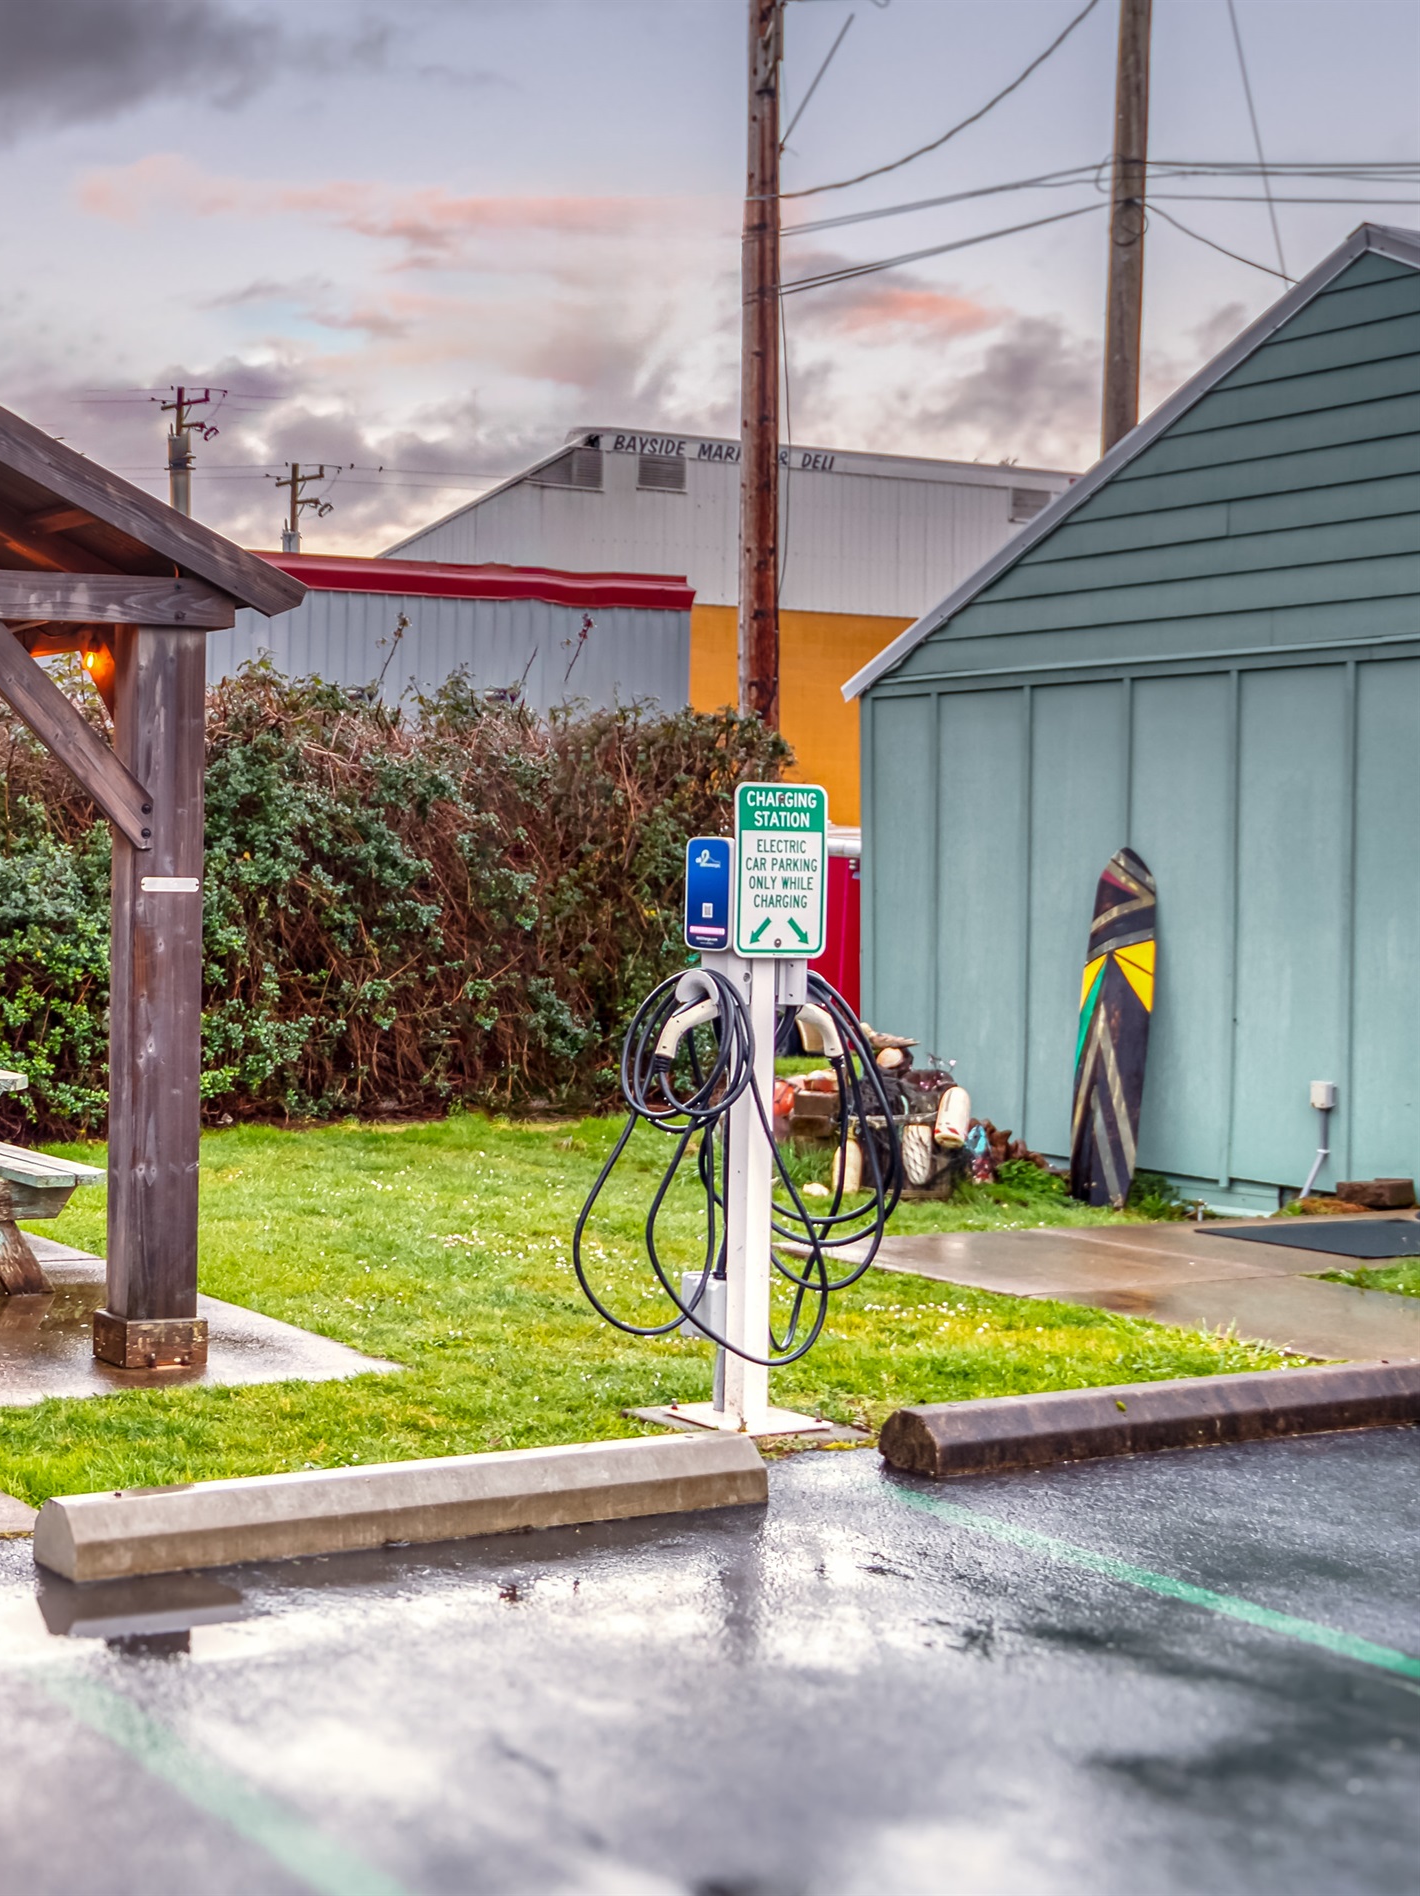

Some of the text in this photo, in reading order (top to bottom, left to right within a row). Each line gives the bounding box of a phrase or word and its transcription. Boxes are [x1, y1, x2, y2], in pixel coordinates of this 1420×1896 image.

[614, 435, 685, 457] BAYSIDE
[801, 452, 835, 471] DELI
[746, 790, 817, 808] CHARGING
[754, 811, 810, 827] STATION
[756, 839, 806, 854] ELECTRIC
[745, 857, 817, 872] CAR PARKING
[748, 876, 814, 890] ONLY WHILE
[753, 894, 808, 908] CHARGING
